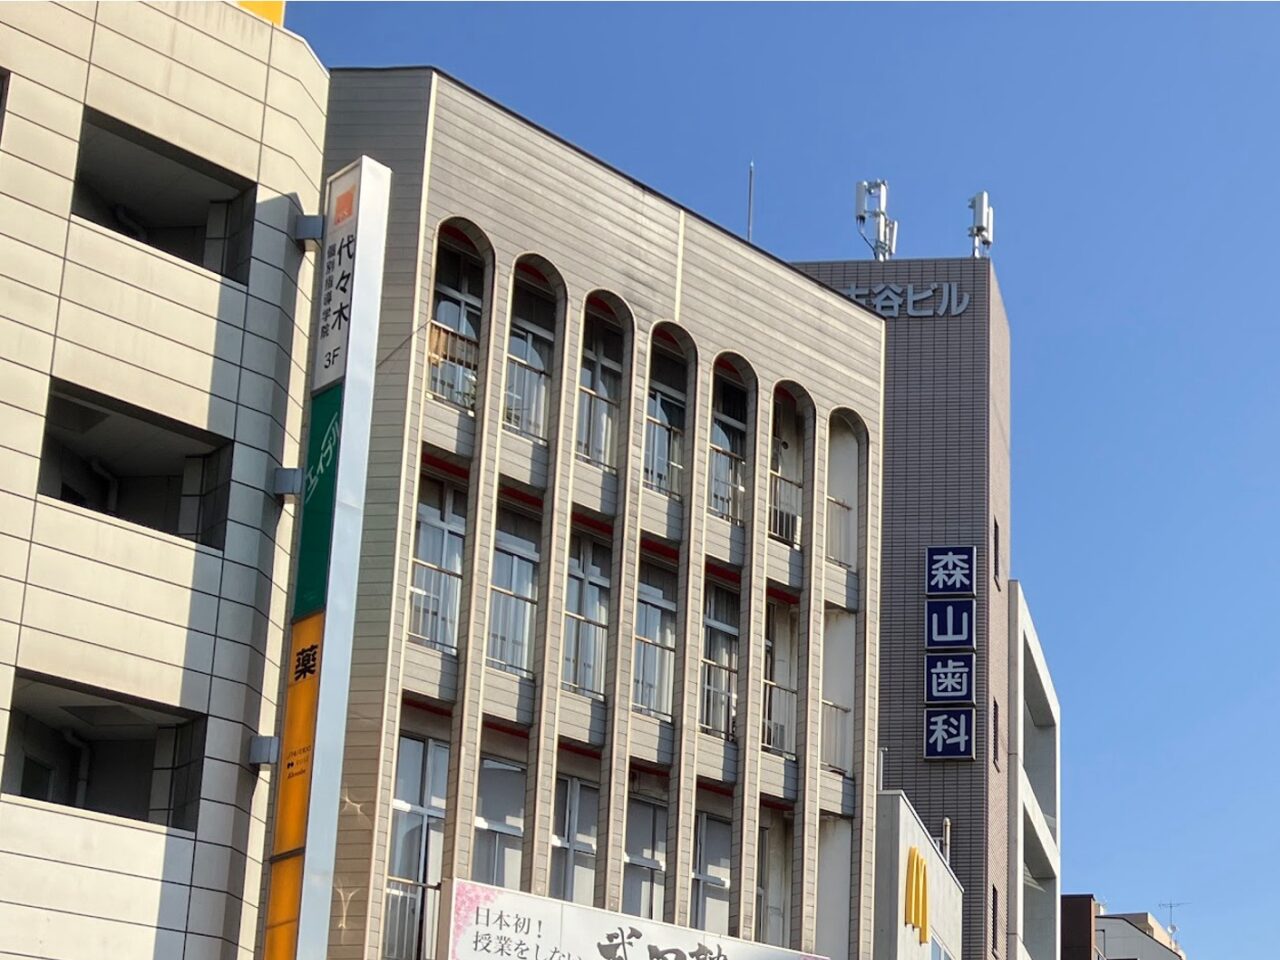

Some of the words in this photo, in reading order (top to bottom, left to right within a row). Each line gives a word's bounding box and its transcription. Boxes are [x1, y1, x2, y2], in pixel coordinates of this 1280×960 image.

[330, 234, 355, 330] 代々木
[323, 346, 341, 370] 3F
[294, 644, 318, 681] 薬
[930, 552, 970, 752] 森山歯科
[474, 906, 544, 938] 日本初！
